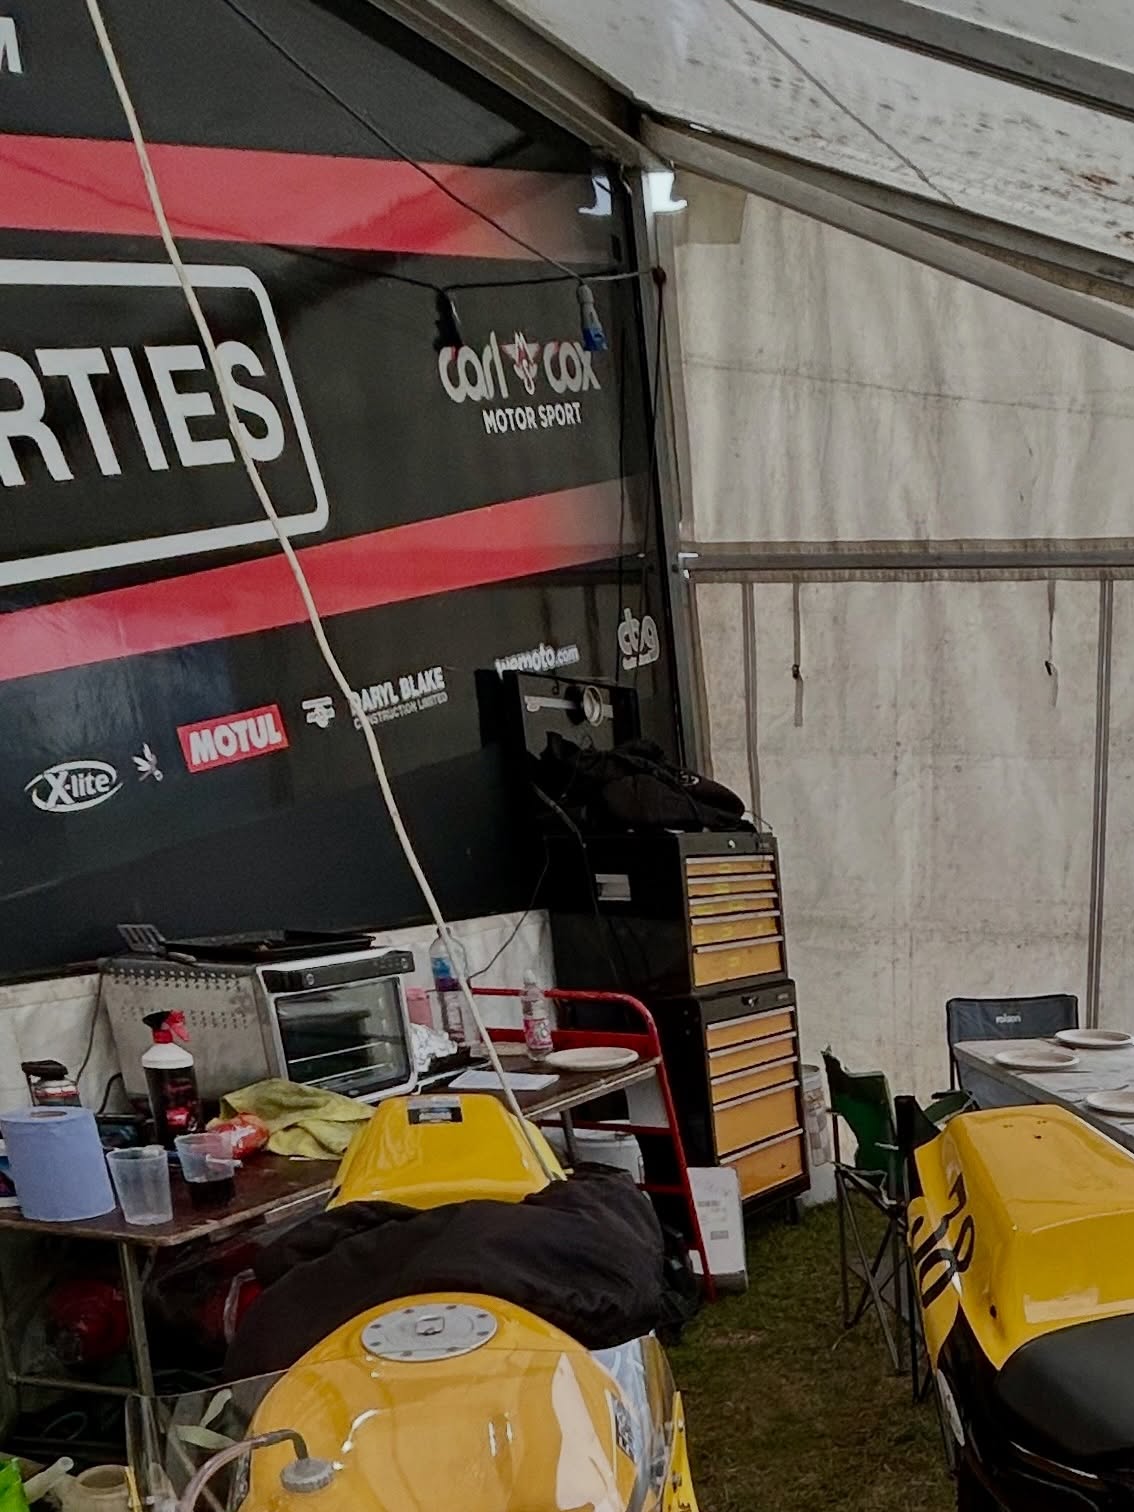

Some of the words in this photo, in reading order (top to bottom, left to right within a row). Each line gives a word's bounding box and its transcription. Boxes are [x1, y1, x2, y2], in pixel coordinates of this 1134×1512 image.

[482, 406, 539, 434] MOTOR
[537, 402, 582, 429] SPORT
[399, 667, 446, 701] BLAKE
[189, 713, 282, 765] MOTUL
